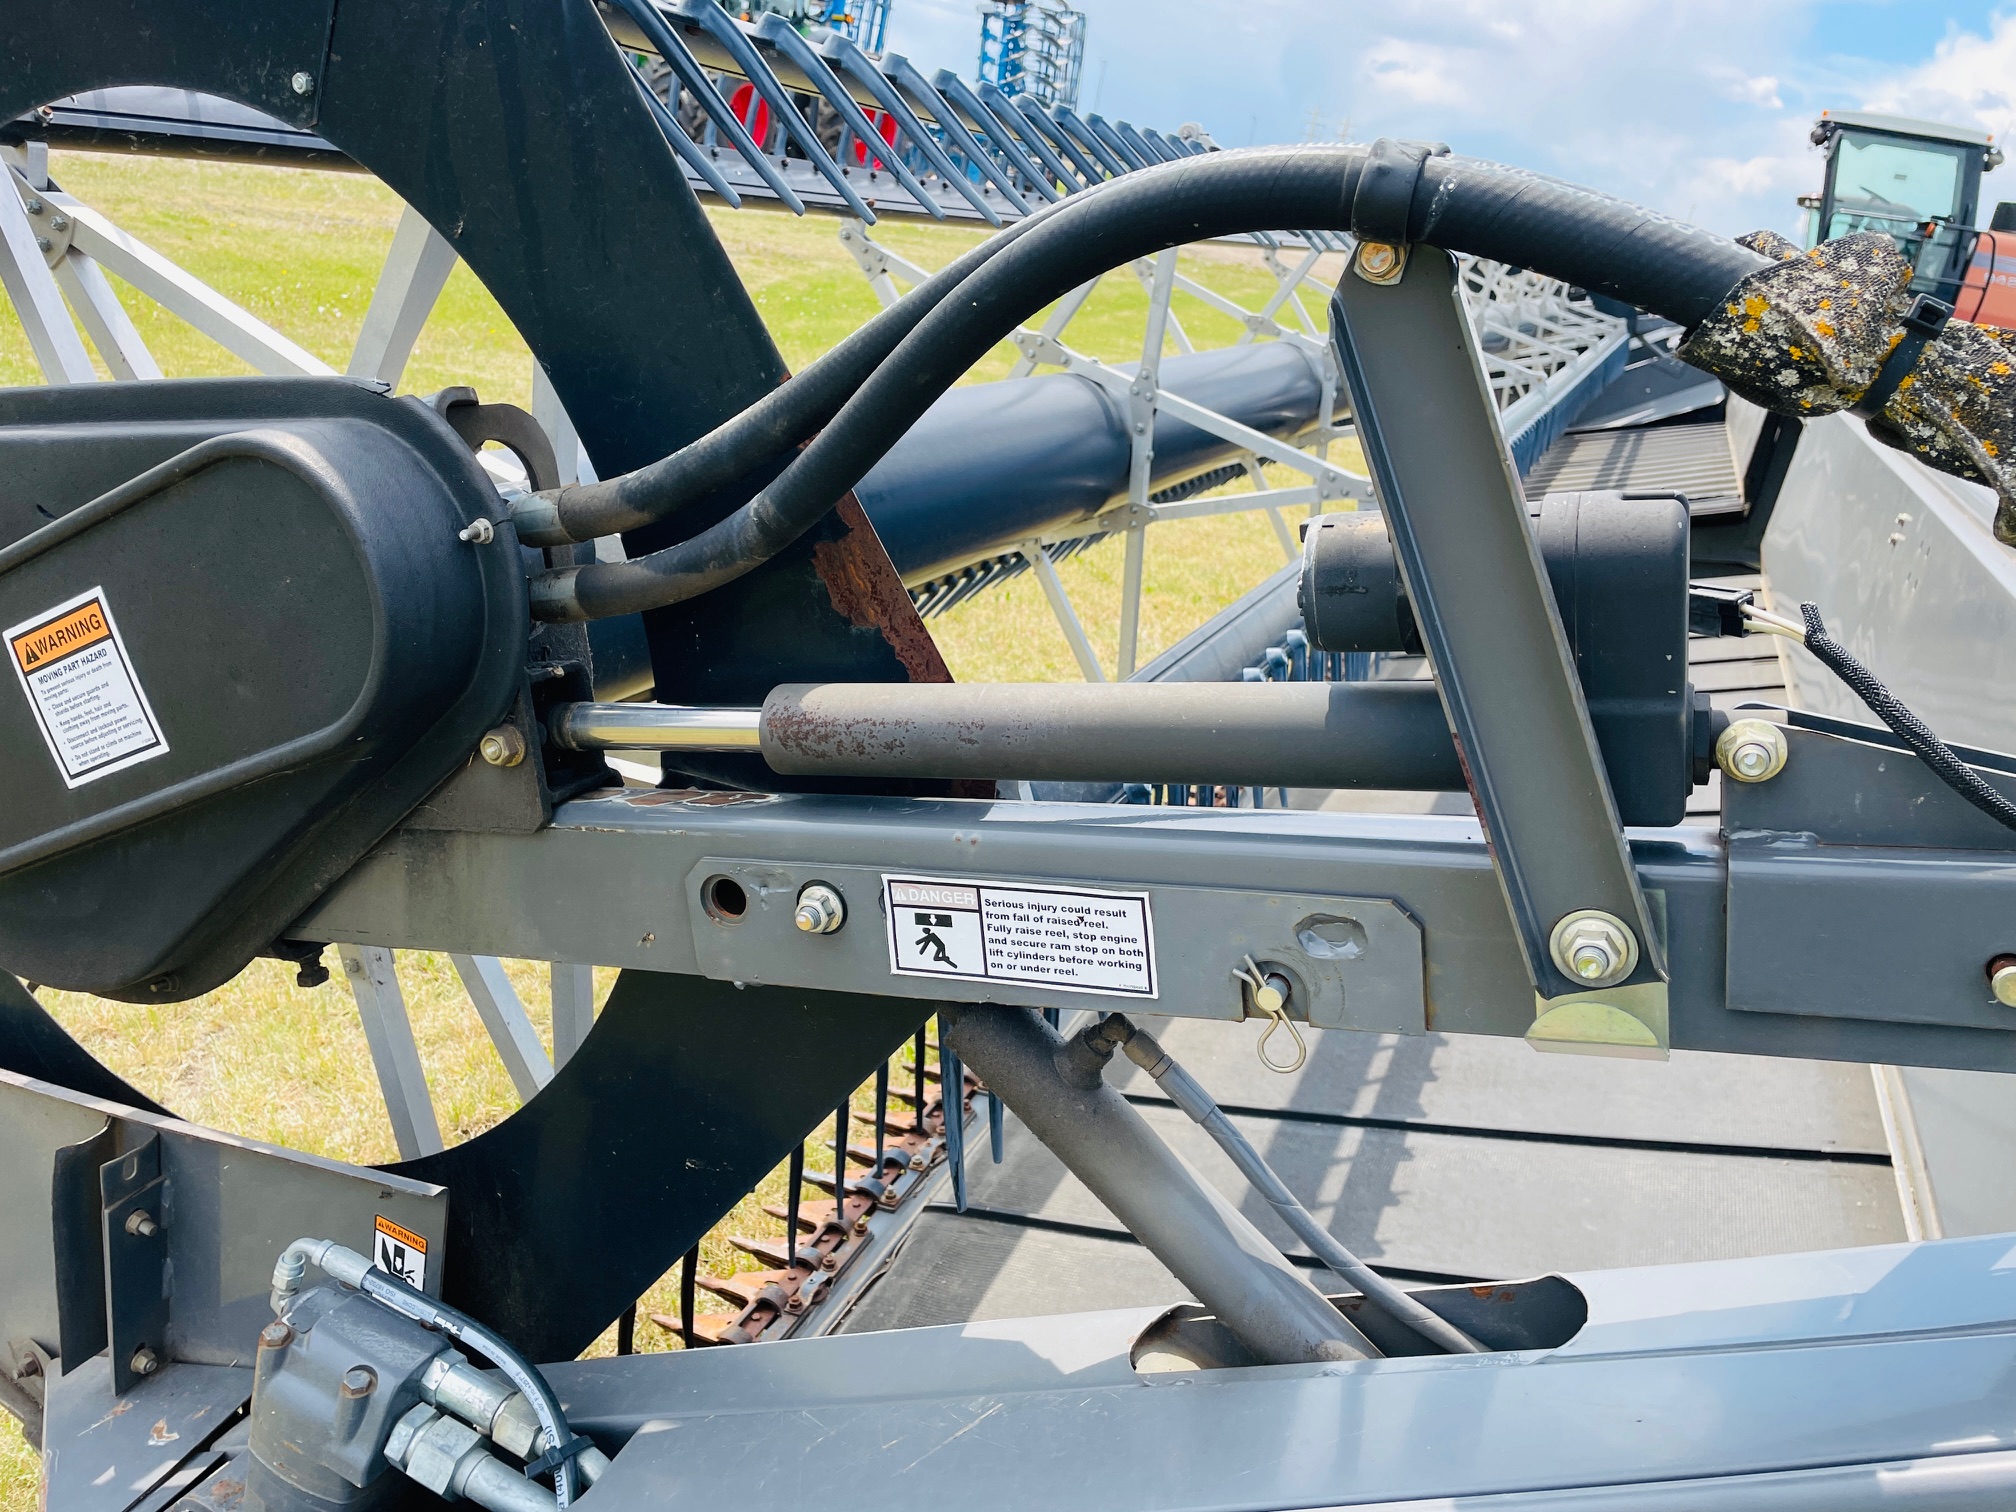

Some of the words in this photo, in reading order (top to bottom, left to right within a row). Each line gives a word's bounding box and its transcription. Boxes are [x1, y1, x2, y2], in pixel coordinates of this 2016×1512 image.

[35, 614, 101, 654] WARNING
[38, 668, 63, 684] MOVING
[63, 660, 79, 673] PART
[81, 649, 107, 665] HAZARD
[47, 684, 61, 694] prevent
[61, 678, 75, 686] serious
[91, 665, 102, 673] death
[44, 693, 58, 701] moving
[52, 702, 63, 710] Close
[64, 697, 72, 705] and
[72, 693, 85, 701] secure
[86, 686, 100, 696] guards
[55, 708, 69, 716] shields
[69, 702, 82, 710] before
[83, 695, 100, 704] starting.
[63, 724, 79, 733] clothing
[101, 708, 116, 717] moving
[116, 704, 129, 712] parts.
[70, 714, 84, 722] hands,
[67, 731, 90, 743] Disconnect
[98, 721, 114, 730] lockout
[114, 716, 127, 725] power
[71, 742, 84, 750] source
[84, 736, 97, 744] before
[98, 728, 117, 739] adjusting
[89, 747, 100, 755] stand
[106, 740, 117, 748] climb
[124, 731, 141, 740] machine
[909, 889, 975, 905] DANGER
[985, 899, 1024, 909] Serious
[1028, 902, 1057, 913] injury
[986, 911, 1009, 920] from
[1013, 913, 1029, 922] fall
[1033, 915, 1043, 923] of
[1047, 917, 1080, 926] raised
[1084, 920, 1108, 929] reel.
[987, 924, 1011, 934] Fully
[1016, 927, 1041, 935] raise
[1045, 930, 1069, 939] reel,
[1073, 932, 1096, 942] stop
[1101, 935, 1137, 944] engine
[1011, 940, 1046, 948] secure
[1075, 945, 1098, 954] stop
[1119, 948, 1143, 957] both
[990, 949, 1003, 957] lift
[1007, 951, 1055, 961] cylinders
[1059, 955, 1093, 965] before
[1098, 961, 1142, 971] working
[385, 1223, 424, 1248] WARNING
[385, 1288, 397, 1298] ISO
